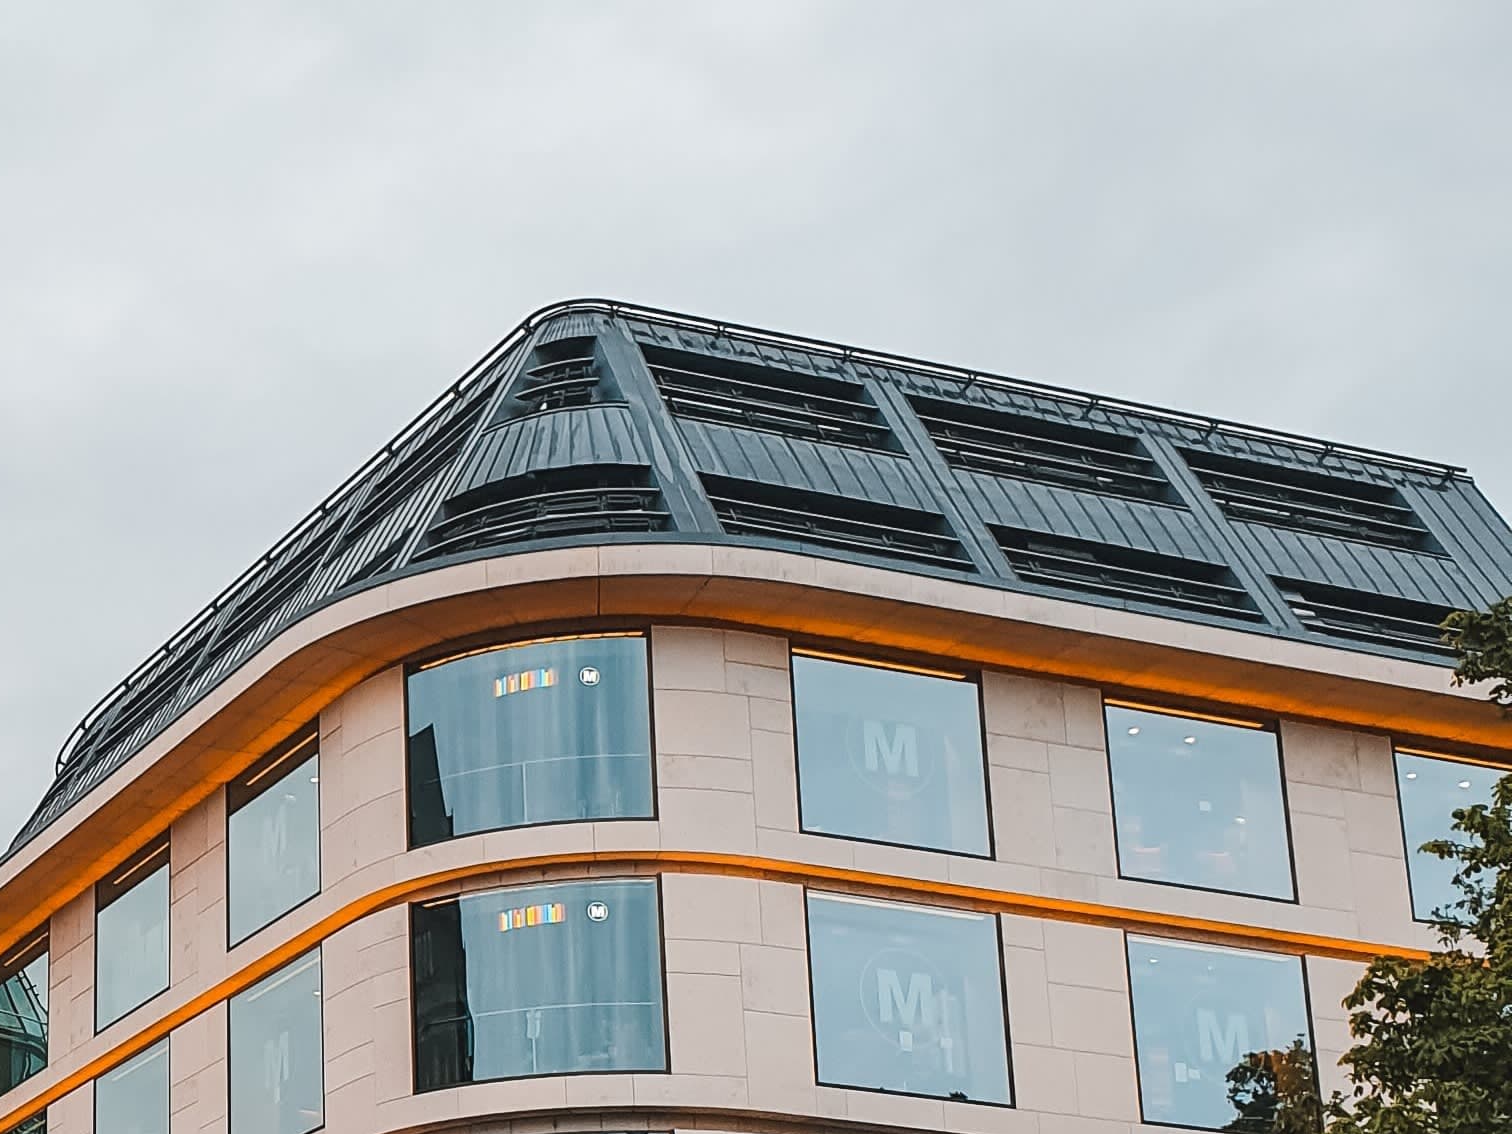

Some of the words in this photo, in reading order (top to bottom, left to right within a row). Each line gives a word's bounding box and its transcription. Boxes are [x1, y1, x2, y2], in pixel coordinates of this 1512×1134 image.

[862, 719, 920, 778] M
[875, 968, 933, 1026] M
[1196, 1007, 1248, 1062] M
